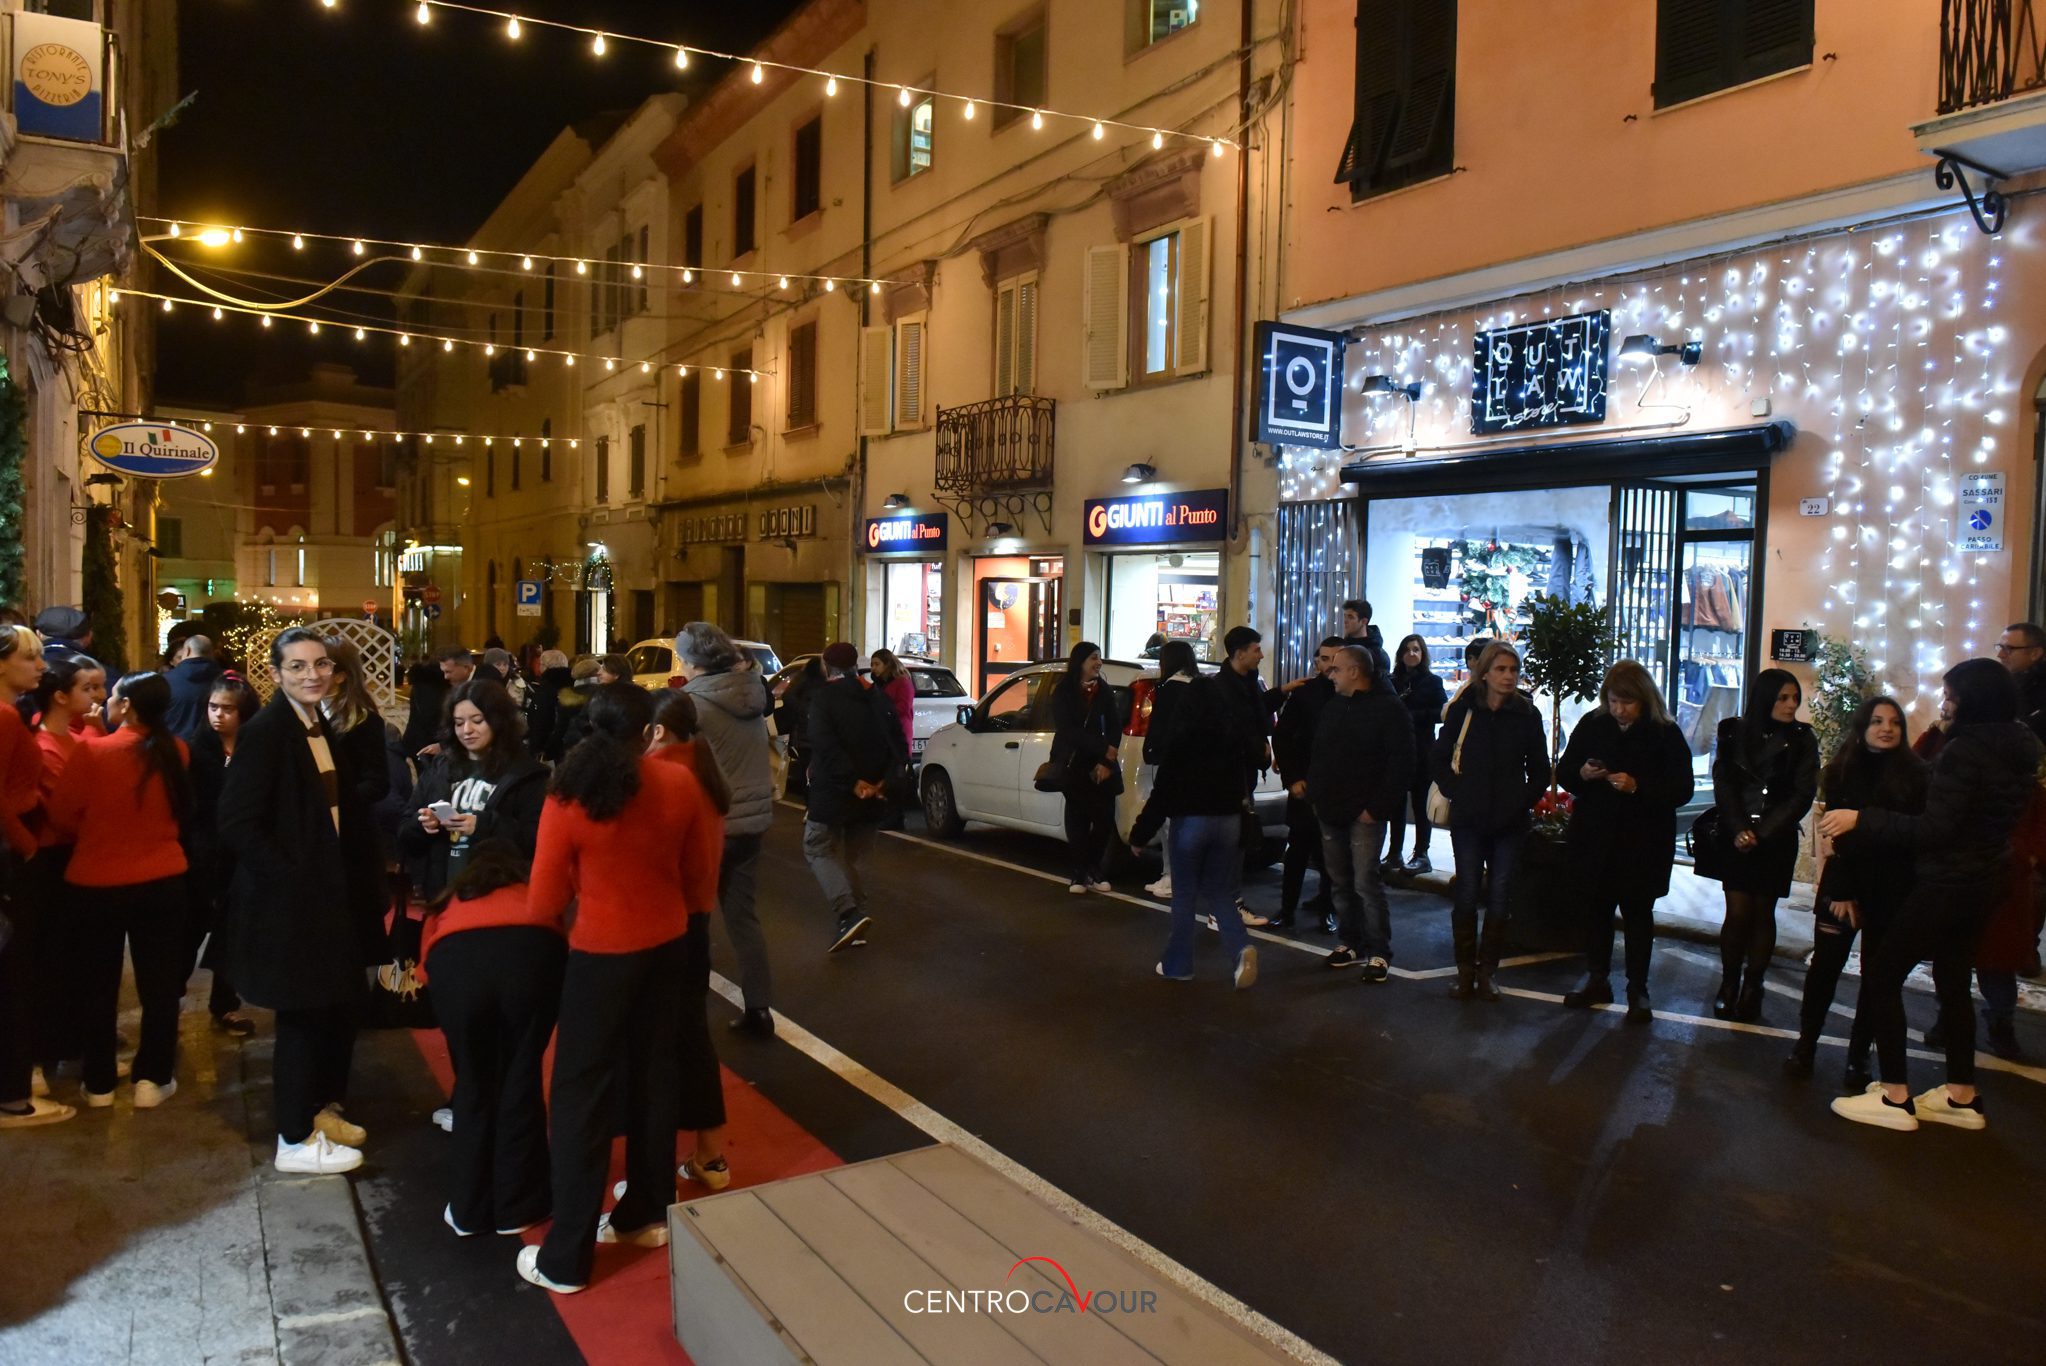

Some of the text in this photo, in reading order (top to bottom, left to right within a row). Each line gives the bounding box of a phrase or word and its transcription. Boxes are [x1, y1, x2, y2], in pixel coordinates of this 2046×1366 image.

[26, 68, 86, 84] TONY'S
[32, 84, 82, 102] PIZZERIA
[1267, 427, 1330, 441] WWW.OUTLAWSTORE.IT
[123, 442, 135, 454] Il
[140, 443, 210, 459] Quirinale
[1962, 488, 2003, 496] SASSARI
[1107, 501, 1217, 529] GIUNTI al Punto
[1807, 504, 1820, 514] 22
[879, 520, 940, 541] GIUNTI al Punto
[522, 583, 537, 602] P
